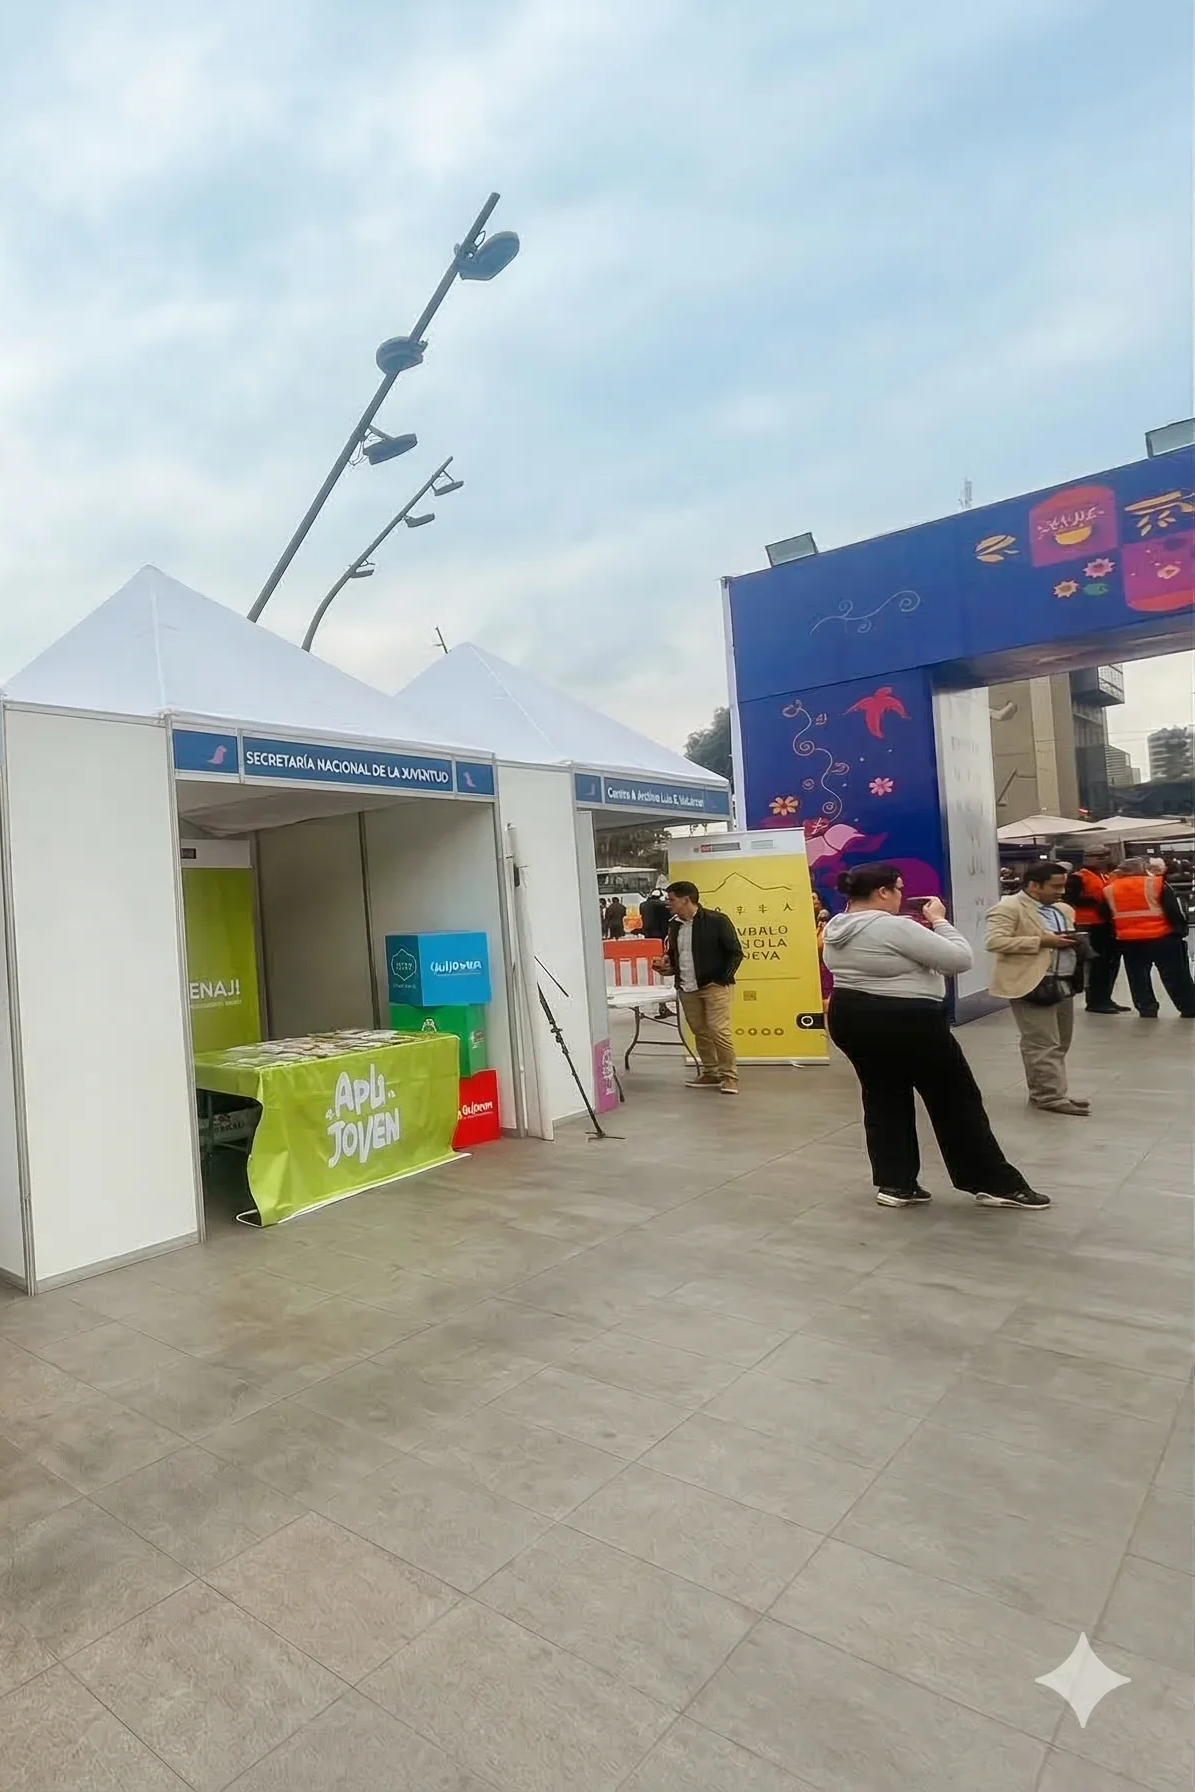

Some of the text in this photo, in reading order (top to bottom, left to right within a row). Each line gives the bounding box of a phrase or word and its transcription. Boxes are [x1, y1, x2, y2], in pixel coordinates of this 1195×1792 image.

[246, 751, 315, 771] SECRETARÍA
[317, 758, 371, 777] NACIONAL
[372, 764, 386, 777] DE
[387, 766, 400, 779] LA
[327, 1107, 400, 1169] JOVEN
